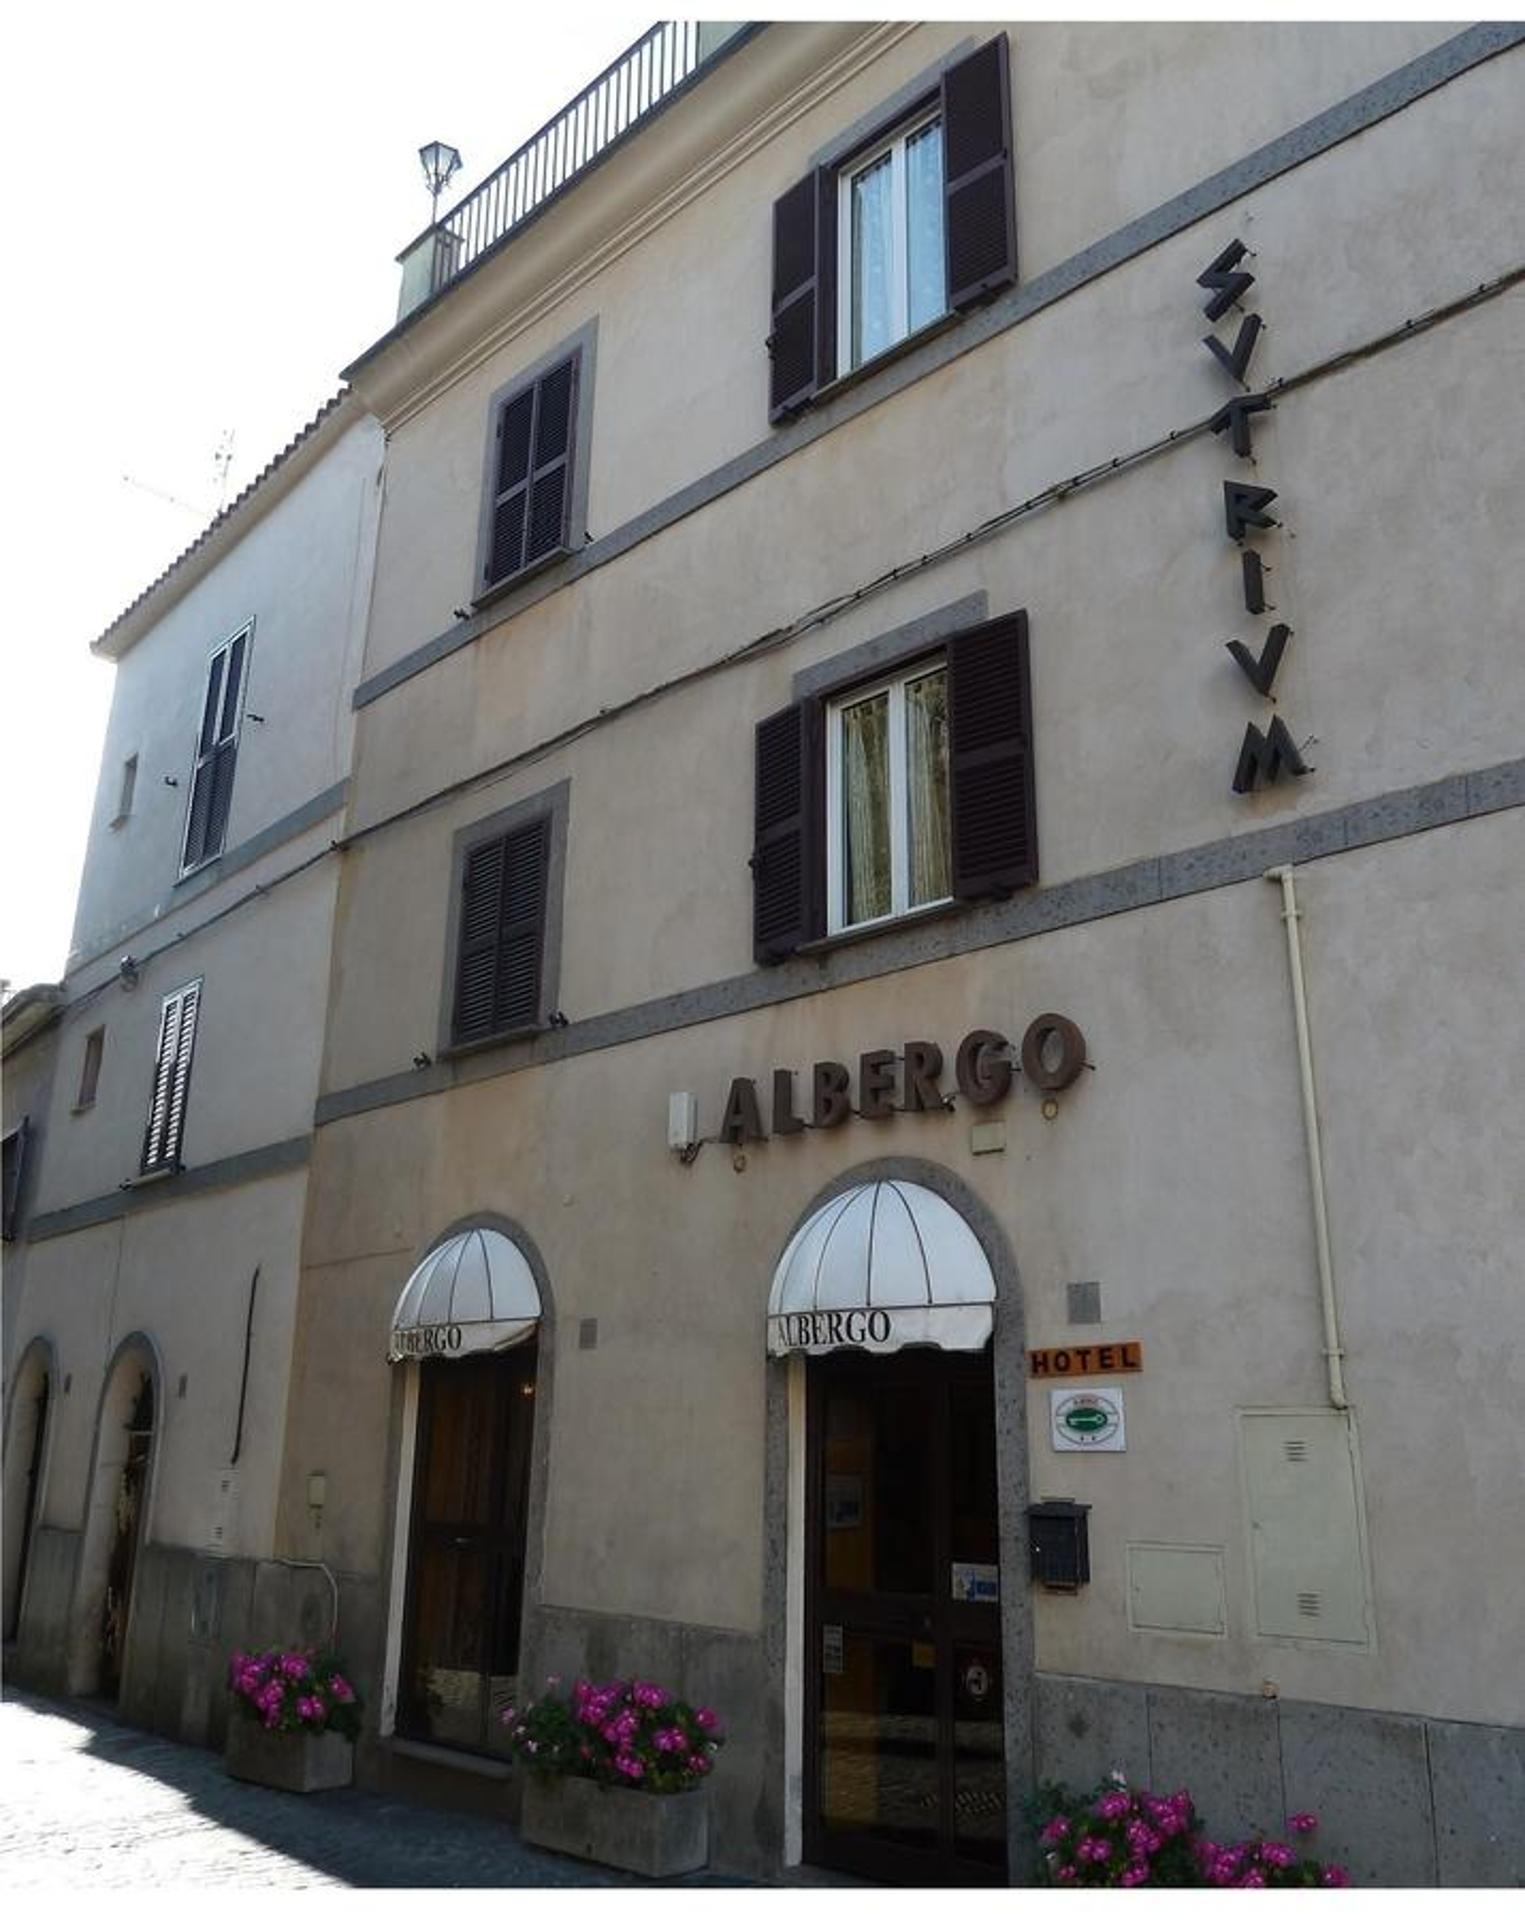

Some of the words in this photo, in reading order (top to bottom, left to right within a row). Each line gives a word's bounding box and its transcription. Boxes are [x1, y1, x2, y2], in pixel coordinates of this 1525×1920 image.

[1196, 238, 1308, 794] SVTRIVM
[719, 1013, 1086, 1145] ALBERGO
[395, 1326, 462, 1353] LBERGO
[777, 1310, 891, 1347] ALBERGO
[1031, 1345, 1136, 1373] HOTEL
